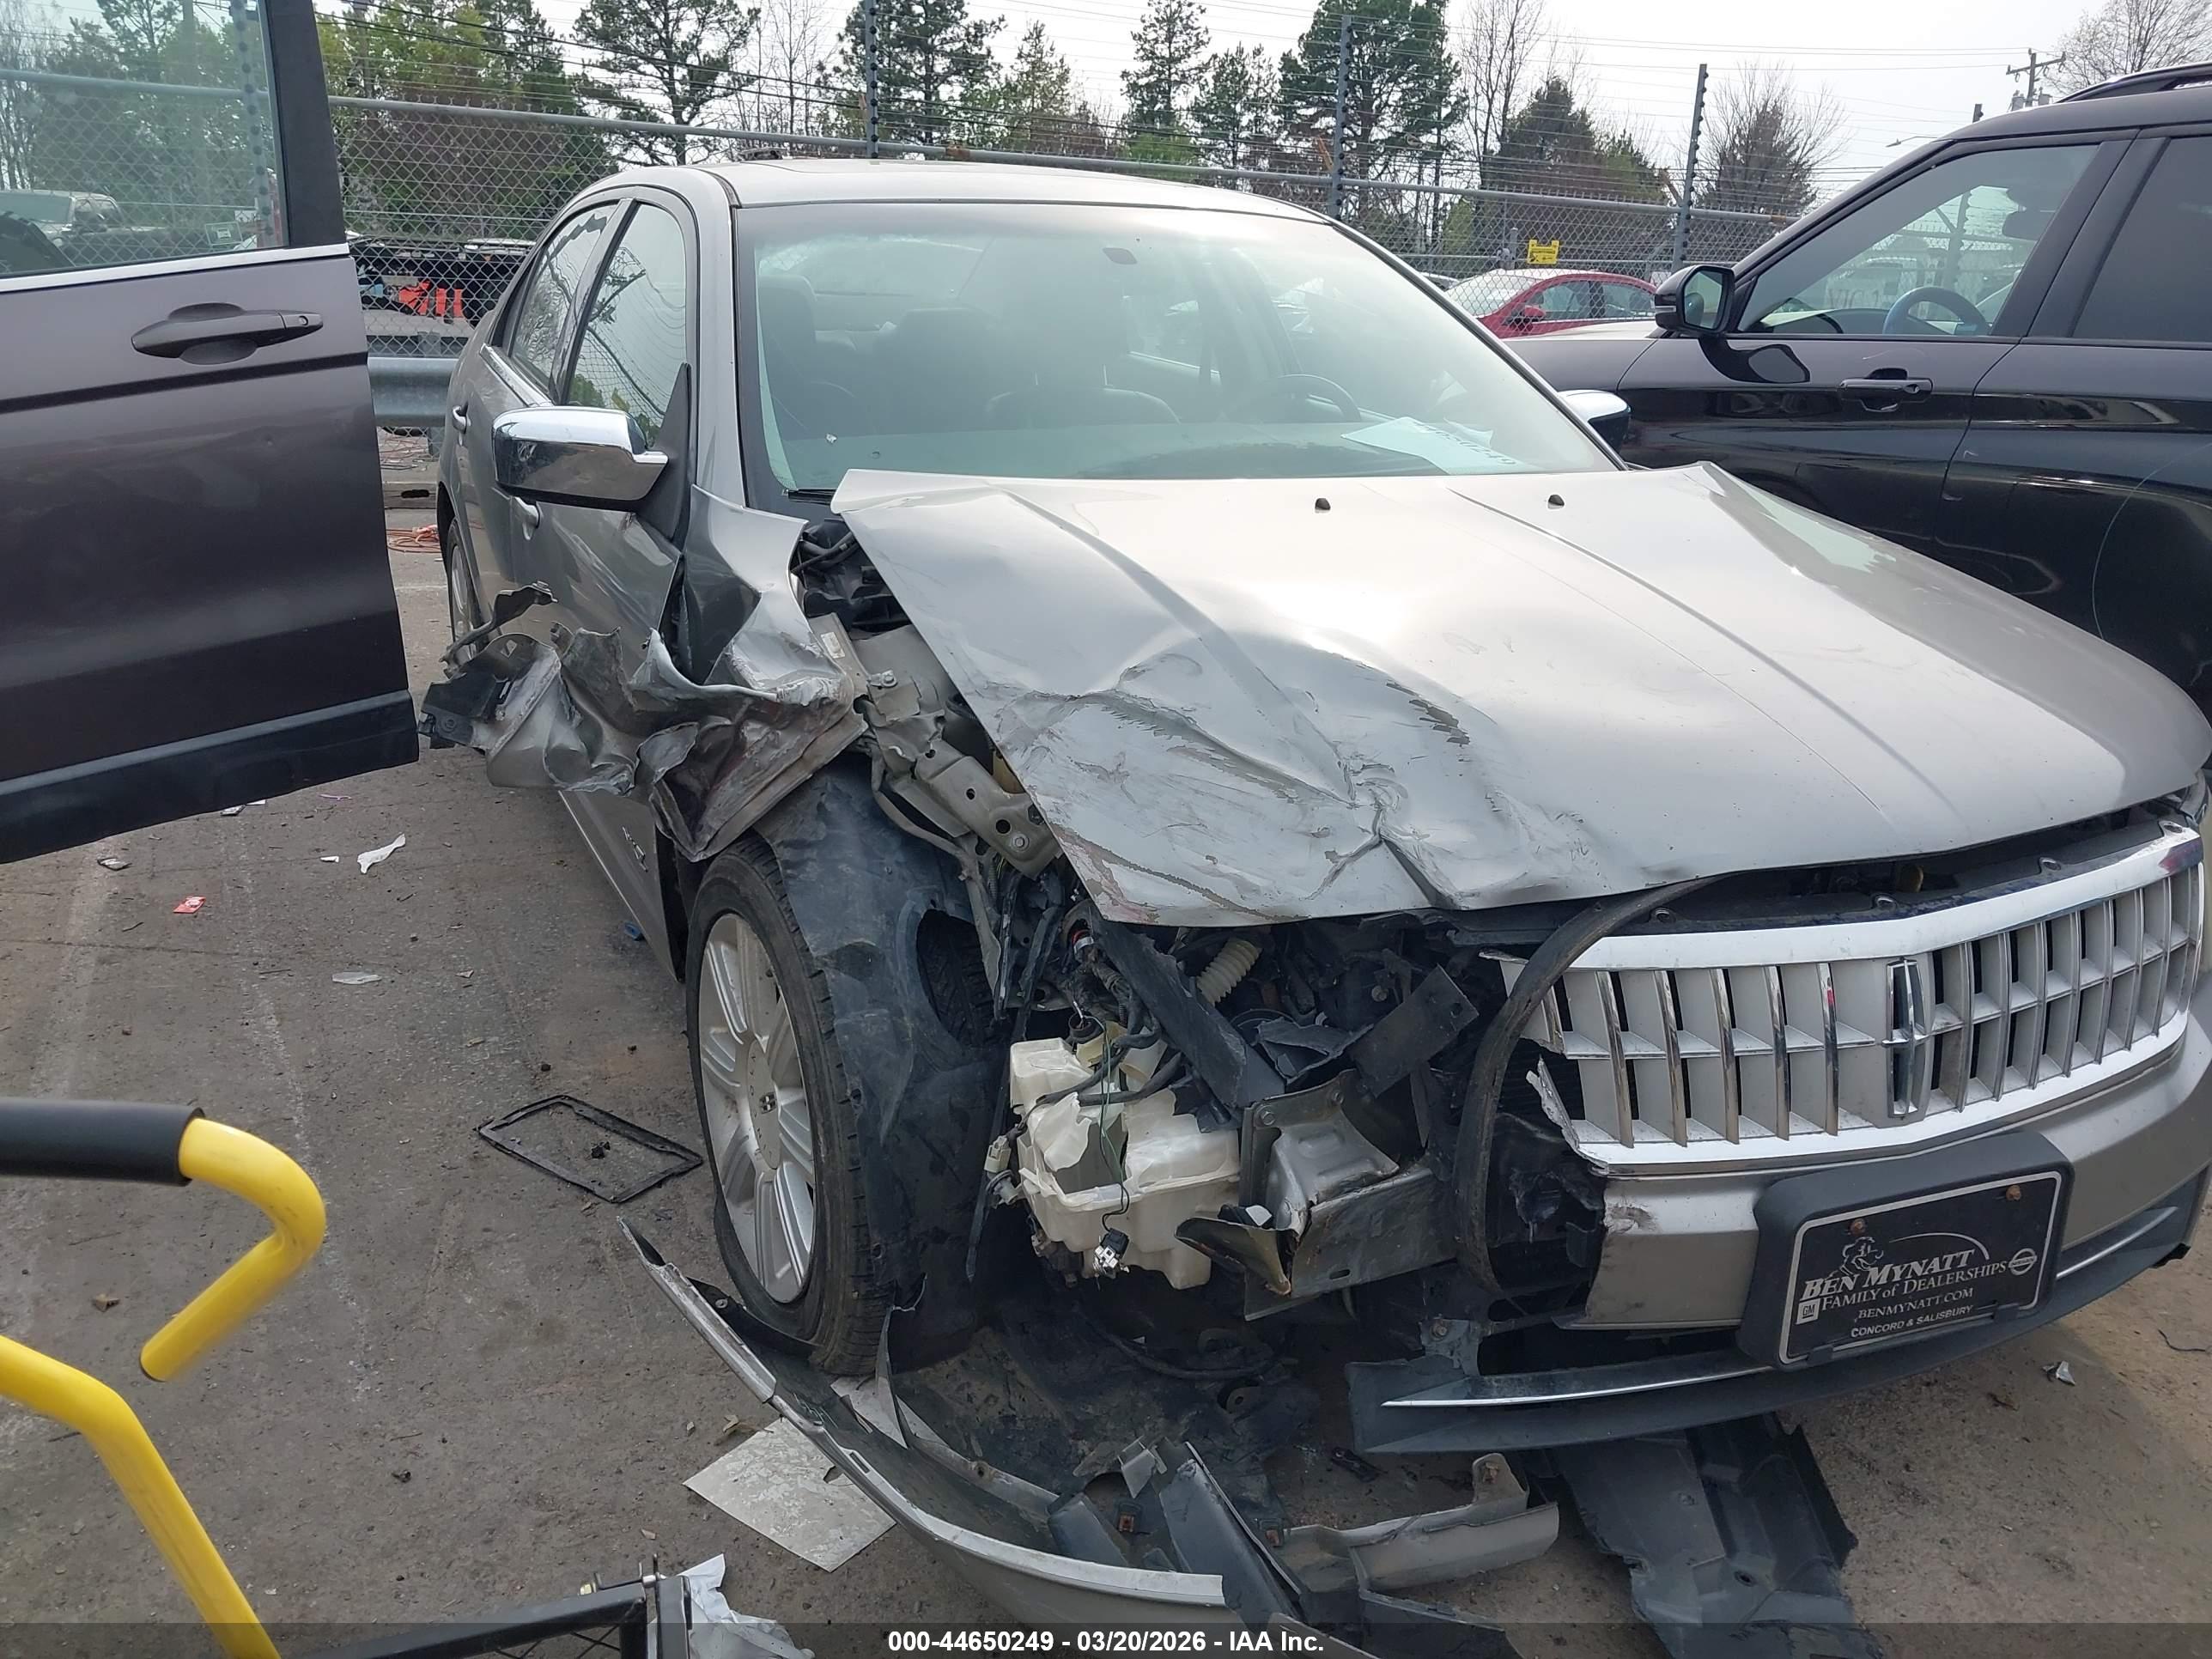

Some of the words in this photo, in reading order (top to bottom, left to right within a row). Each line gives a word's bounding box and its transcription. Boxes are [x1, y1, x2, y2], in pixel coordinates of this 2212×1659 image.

[1799, 1273, 1860, 1302] BEN
[1862, 1249, 1975, 1288] MYNATT
[1821, 1288, 1881, 1310] FAMILY
[1881, 1284, 1899, 1298] of
[1902, 1261, 2008, 1295] DEALERSHIPS
[1850, 1321, 1905, 1338] CONCORD
[1916, 1305, 1973, 1325] SALISBURY
